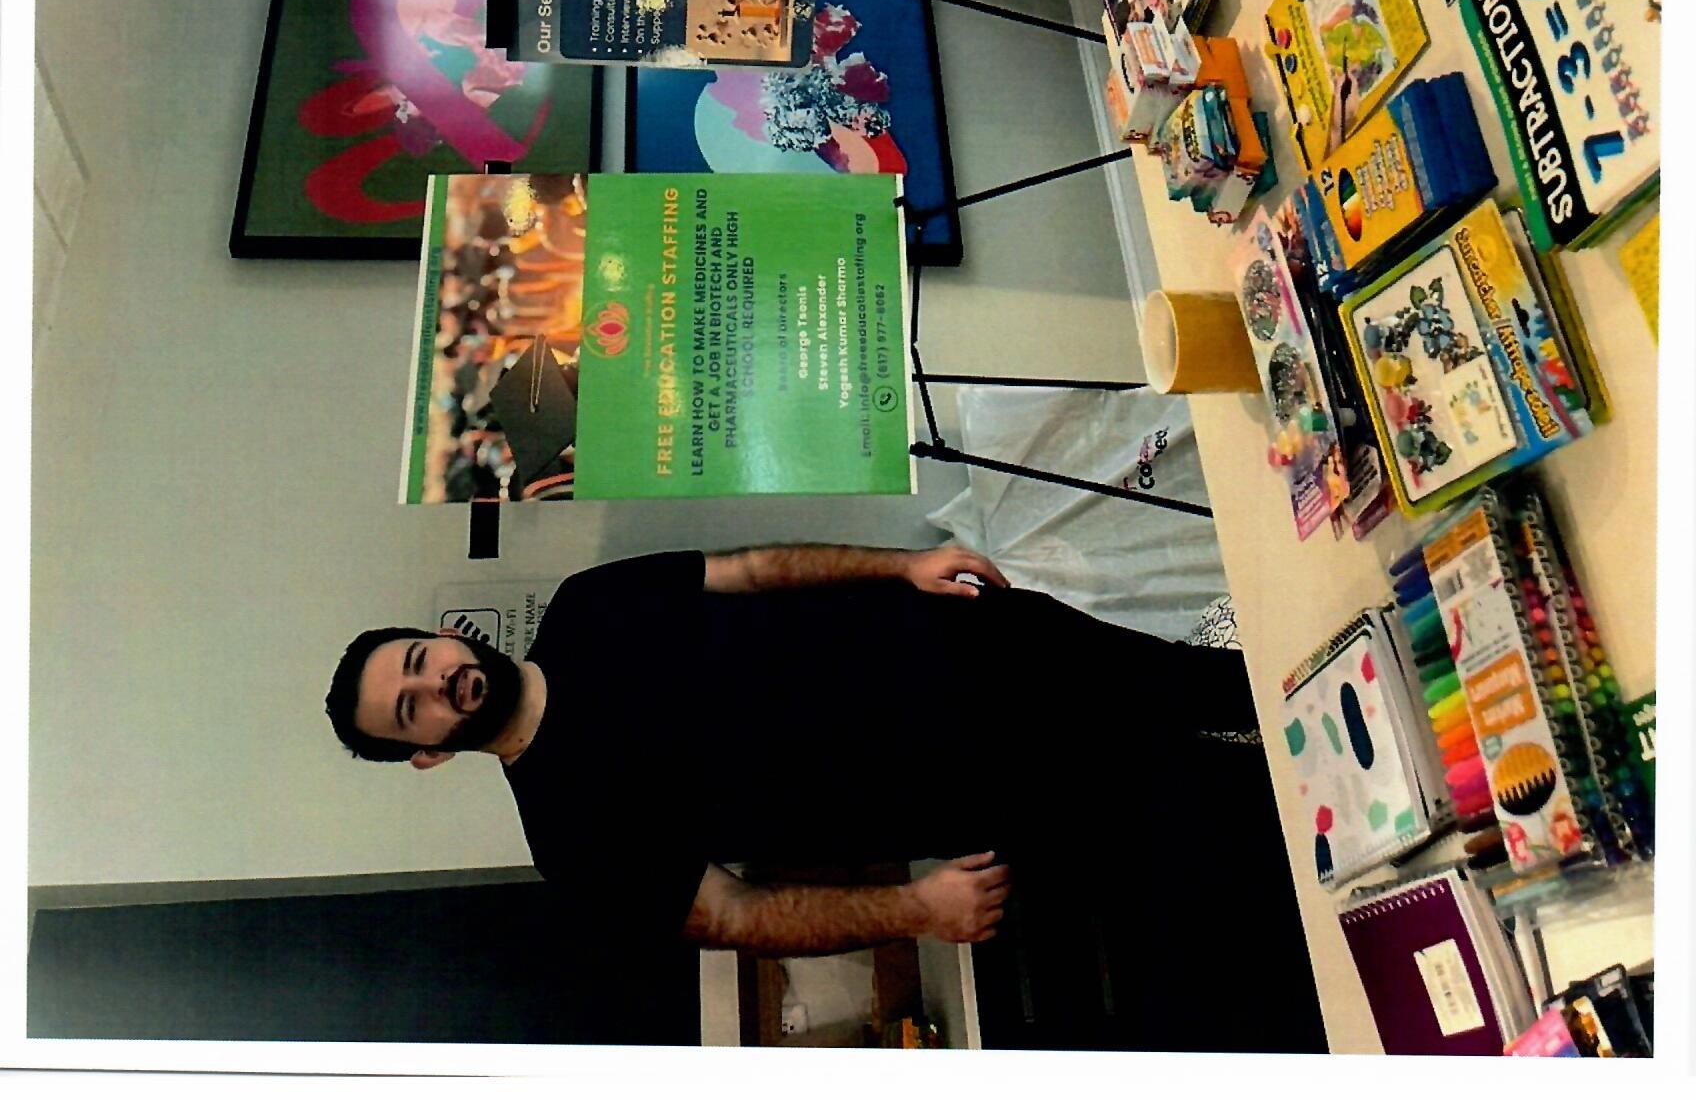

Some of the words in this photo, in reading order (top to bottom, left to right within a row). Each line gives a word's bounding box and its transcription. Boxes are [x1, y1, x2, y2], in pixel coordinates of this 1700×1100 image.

[537, 21, 552, 53] Our
[636, 28, 646, 44] On
[1320, 168, 1335, 197] 12
[696, 188, 708, 220] AND
[661, 186, 680, 285] STAFFING
[710, 227, 722, 259] AND
[726, 211, 738, 248] HIGH
[694, 224, 708, 303] MEDICINES
[726, 252, 739, 291] ONLY
[836, 258, 848, 308] Sharma
[1316, 259, 1329, 284] 12
[709, 262, 722, 327] BIOTECH
[742, 257, 754, 329] REQUIRED
[777, 273, 788, 332] Directors
[816, 274, 828, 341] Alexander
[694, 308, 706, 350] MAKE
[709, 331, 722, 347] IN
[777, 335, 788, 348] of
[838, 310, 848, 355] Kumar
[658, 292, 678, 417] EDUCATION
[692, 354, 705, 374] TO
[708, 350, 722, 382] JOB
[724, 294, 738, 448] PHARMACEUTICALS
[742, 332, 754, 398] SCHOOL
[797, 330, 811, 378] George
[818, 344, 829, 391] Steven
[692, 380, 705, 420] HOW
[709, 386, 721, 398] A
[838, 358, 852, 408] Yogesh
[708, 402, 721, 432] GET
[656, 424, 674, 476] FREE
[691, 424, 704, 476] LEARN
[525, 592, 536, 625] NAME
